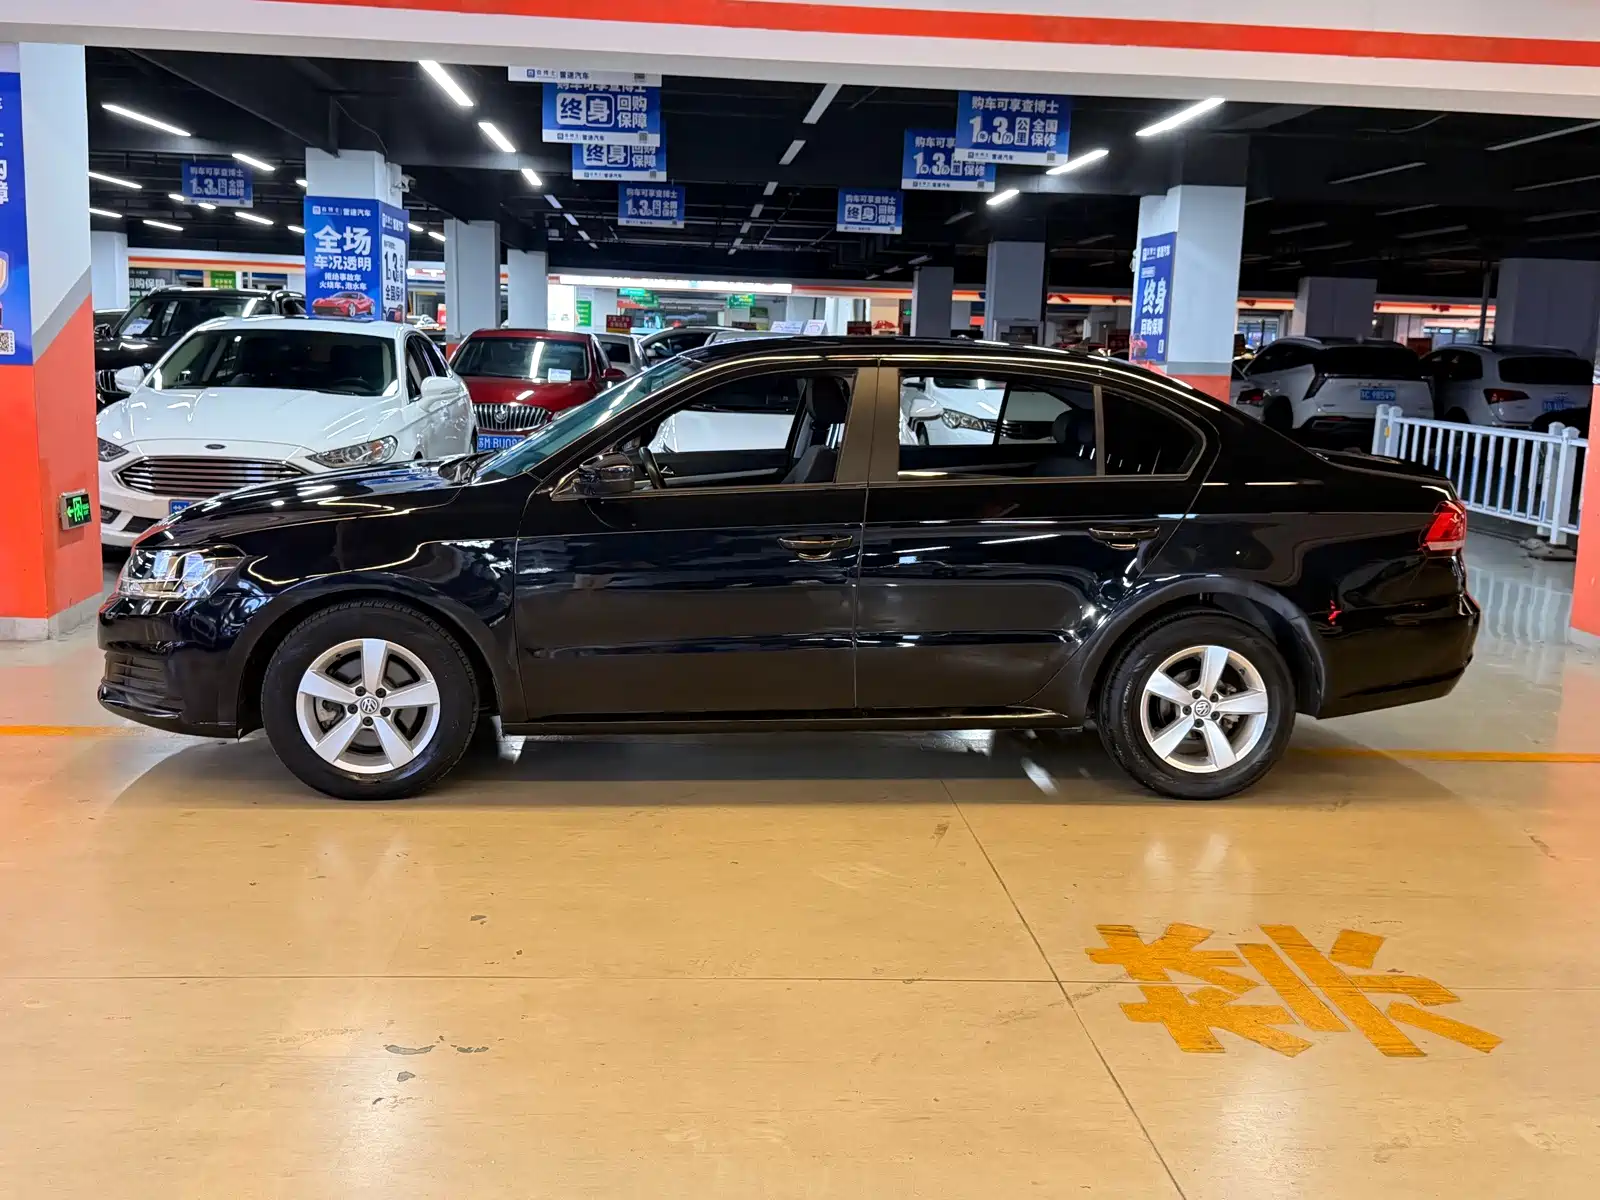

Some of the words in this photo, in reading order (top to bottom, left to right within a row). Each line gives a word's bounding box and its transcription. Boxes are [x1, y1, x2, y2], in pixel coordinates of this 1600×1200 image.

[560, 97, 610, 122] 终身
[617, 95, 647, 112] 回购
[972, 95, 1059, 114] 购车可享查博士
[617, 112, 647, 128] 保障
[1032, 118, 1058, 133] 全国
[1031, 133, 1057, 147] 保修
[586, 144, 626, 163] 终身
[632, 155, 656, 168] 保障
[964, 164, 985, 176] 保修
[847, 206, 875, 221] 终身
[313, 225, 372, 256] 全场
[314, 255, 372, 272] 车况透明
[324, 272, 361, 282] 拒绝事故车
[1142, 277, 1167, 314] 终身
